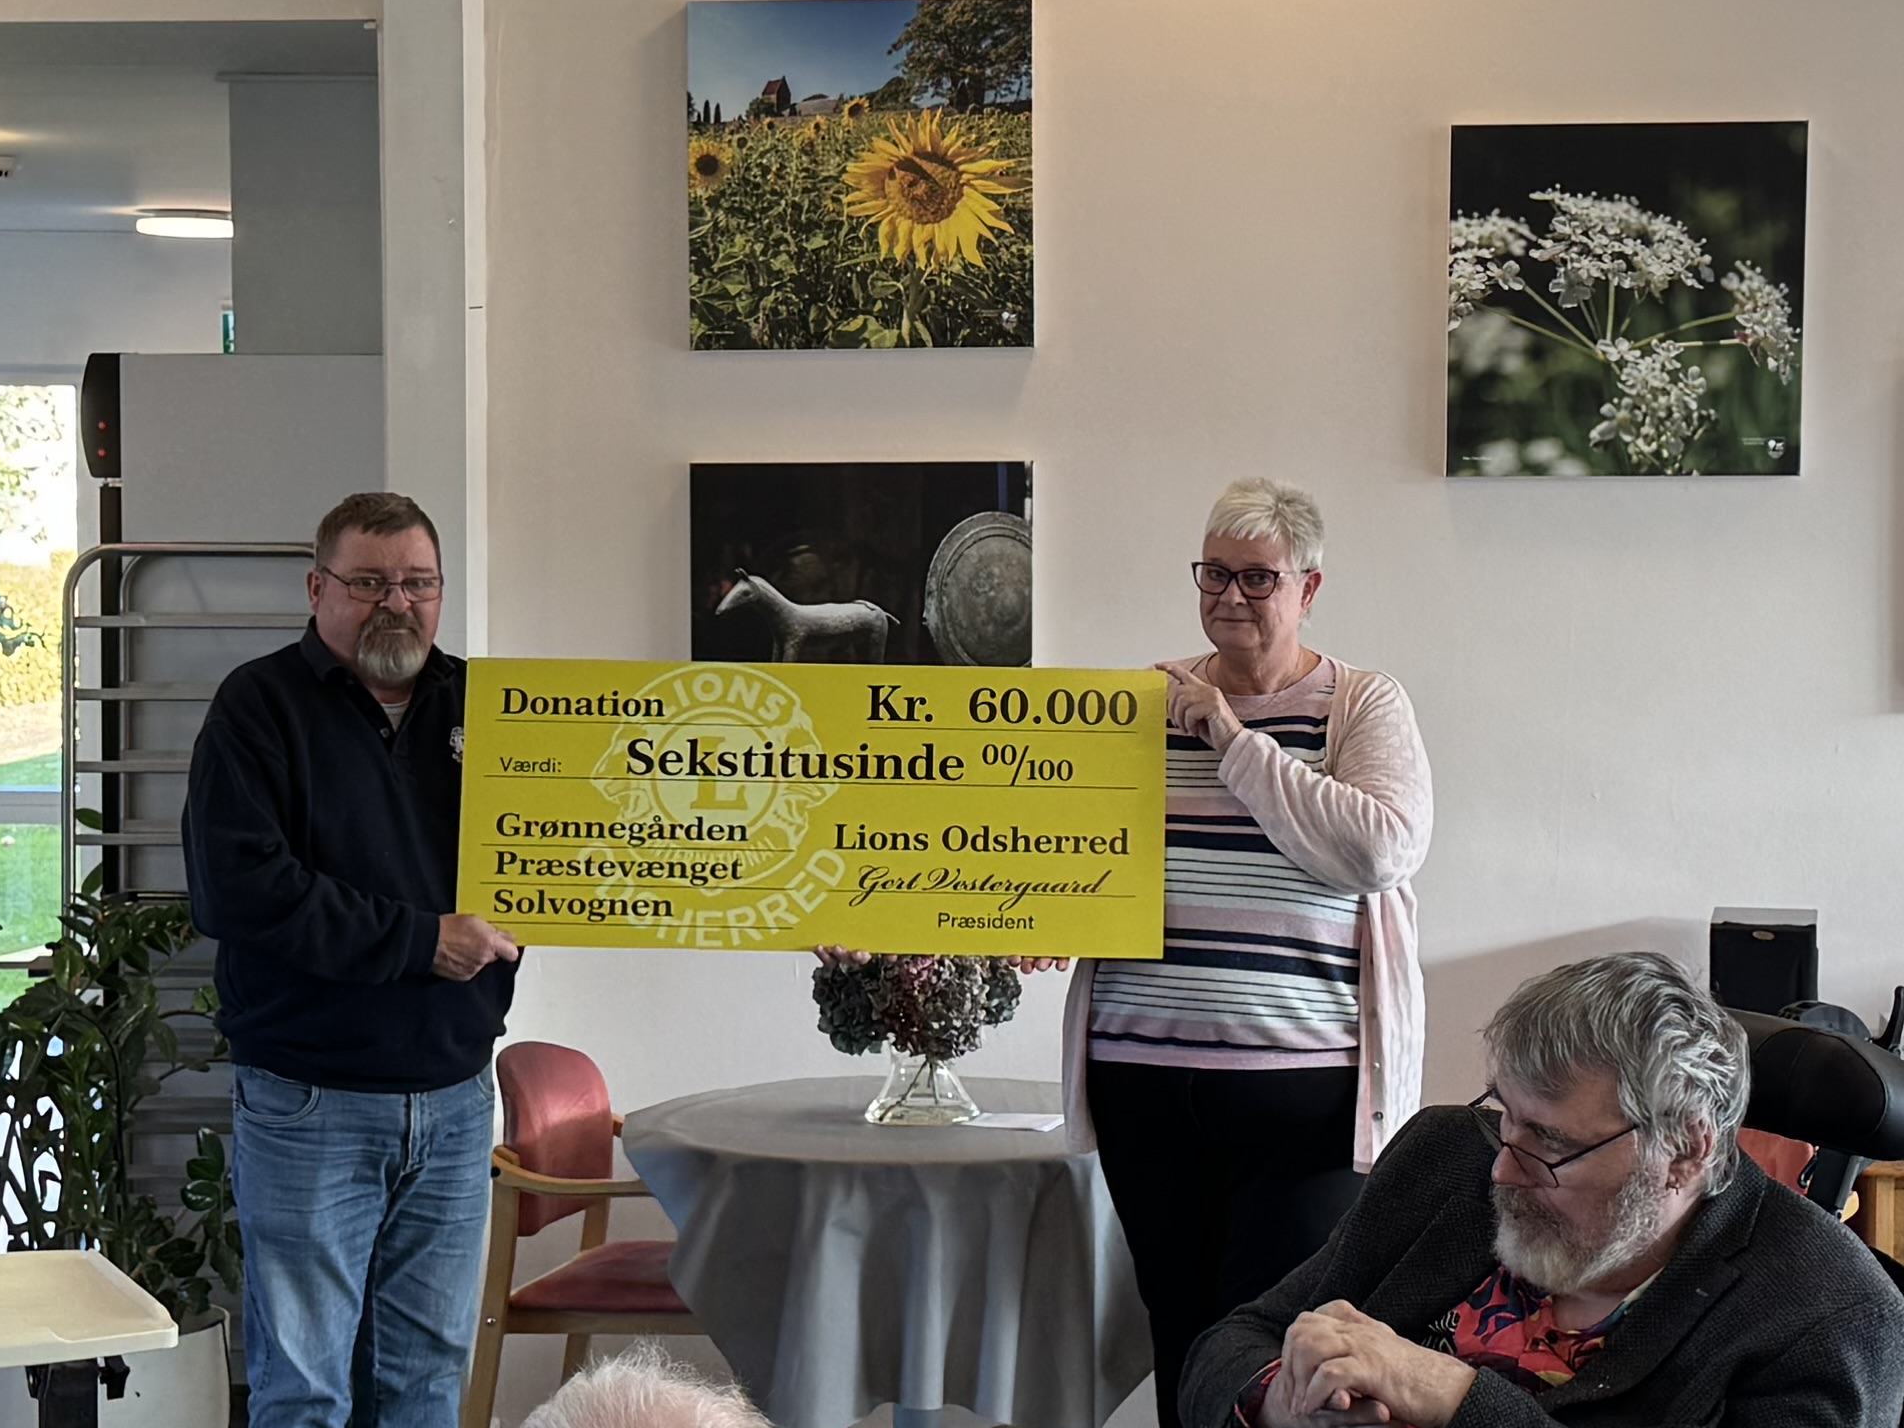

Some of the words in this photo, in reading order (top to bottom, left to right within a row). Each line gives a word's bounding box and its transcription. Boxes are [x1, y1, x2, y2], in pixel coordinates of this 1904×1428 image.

[500, 687, 666, 719] Donation
[866, 684, 934, 723] Kr.
[968, 687, 1138, 726] 60.000
[499, 756, 563, 773] Værdi:
[625, 737, 966, 781] Sekstitusinde
[495, 812, 750, 847] Grønnegården
[833, 823, 930, 852] Lions
[941, 824, 1130, 856] Odsherred
[494, 850, 744, 887] Præstevænget
[493, 888, 675, 923] Solvognen
[848, 864, 922, 907] Gert
[921, 867, 1113, 912] Vestergaard
[937, 912, 1035, 930] Præsident
